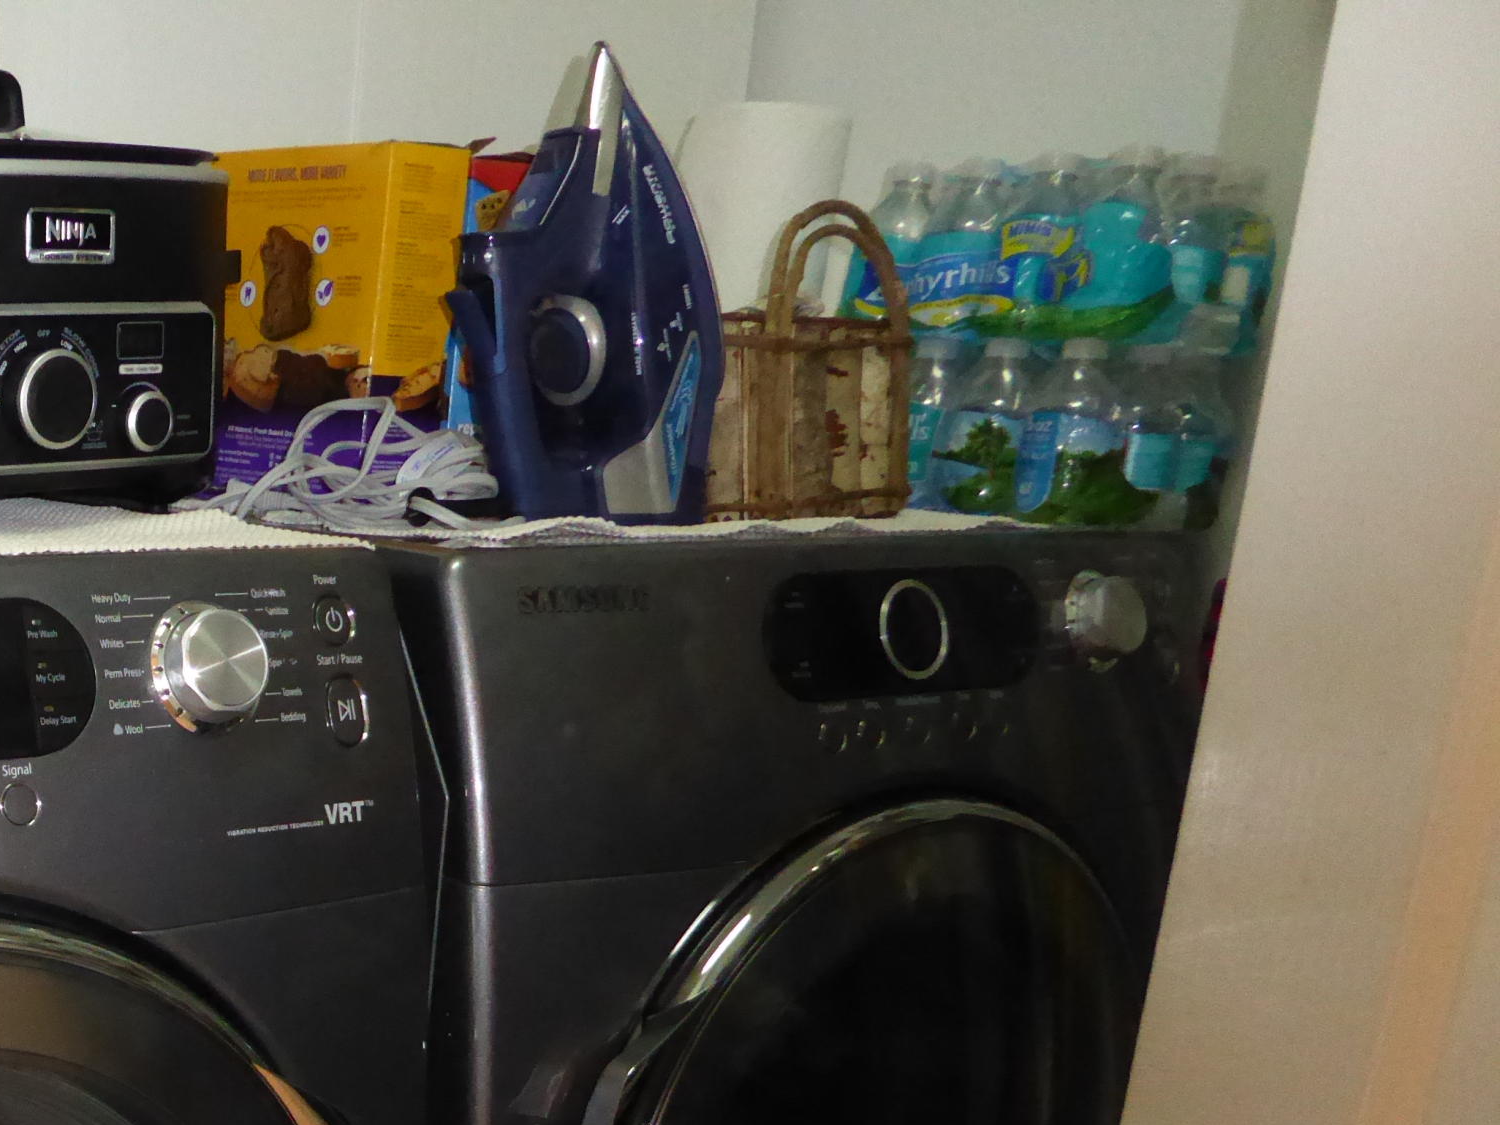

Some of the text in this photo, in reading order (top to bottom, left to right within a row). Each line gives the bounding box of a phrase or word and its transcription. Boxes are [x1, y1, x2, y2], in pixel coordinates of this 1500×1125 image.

[312, 574, 337, 585] Power
[91, 592, 131, 606] Heavy Duty
[95, 614, 122, 624] Normal
[100, 639, 125, 649] Whites
[47, 673, 66, 684] Cycle
[104, 668, 123, 679] Perm
[108, 699, 141, 710] Delicates
[60, 713, 78, 724] Start
[124, 724, 144, 735] Wool
[1, 762, 33, 779] Signal
